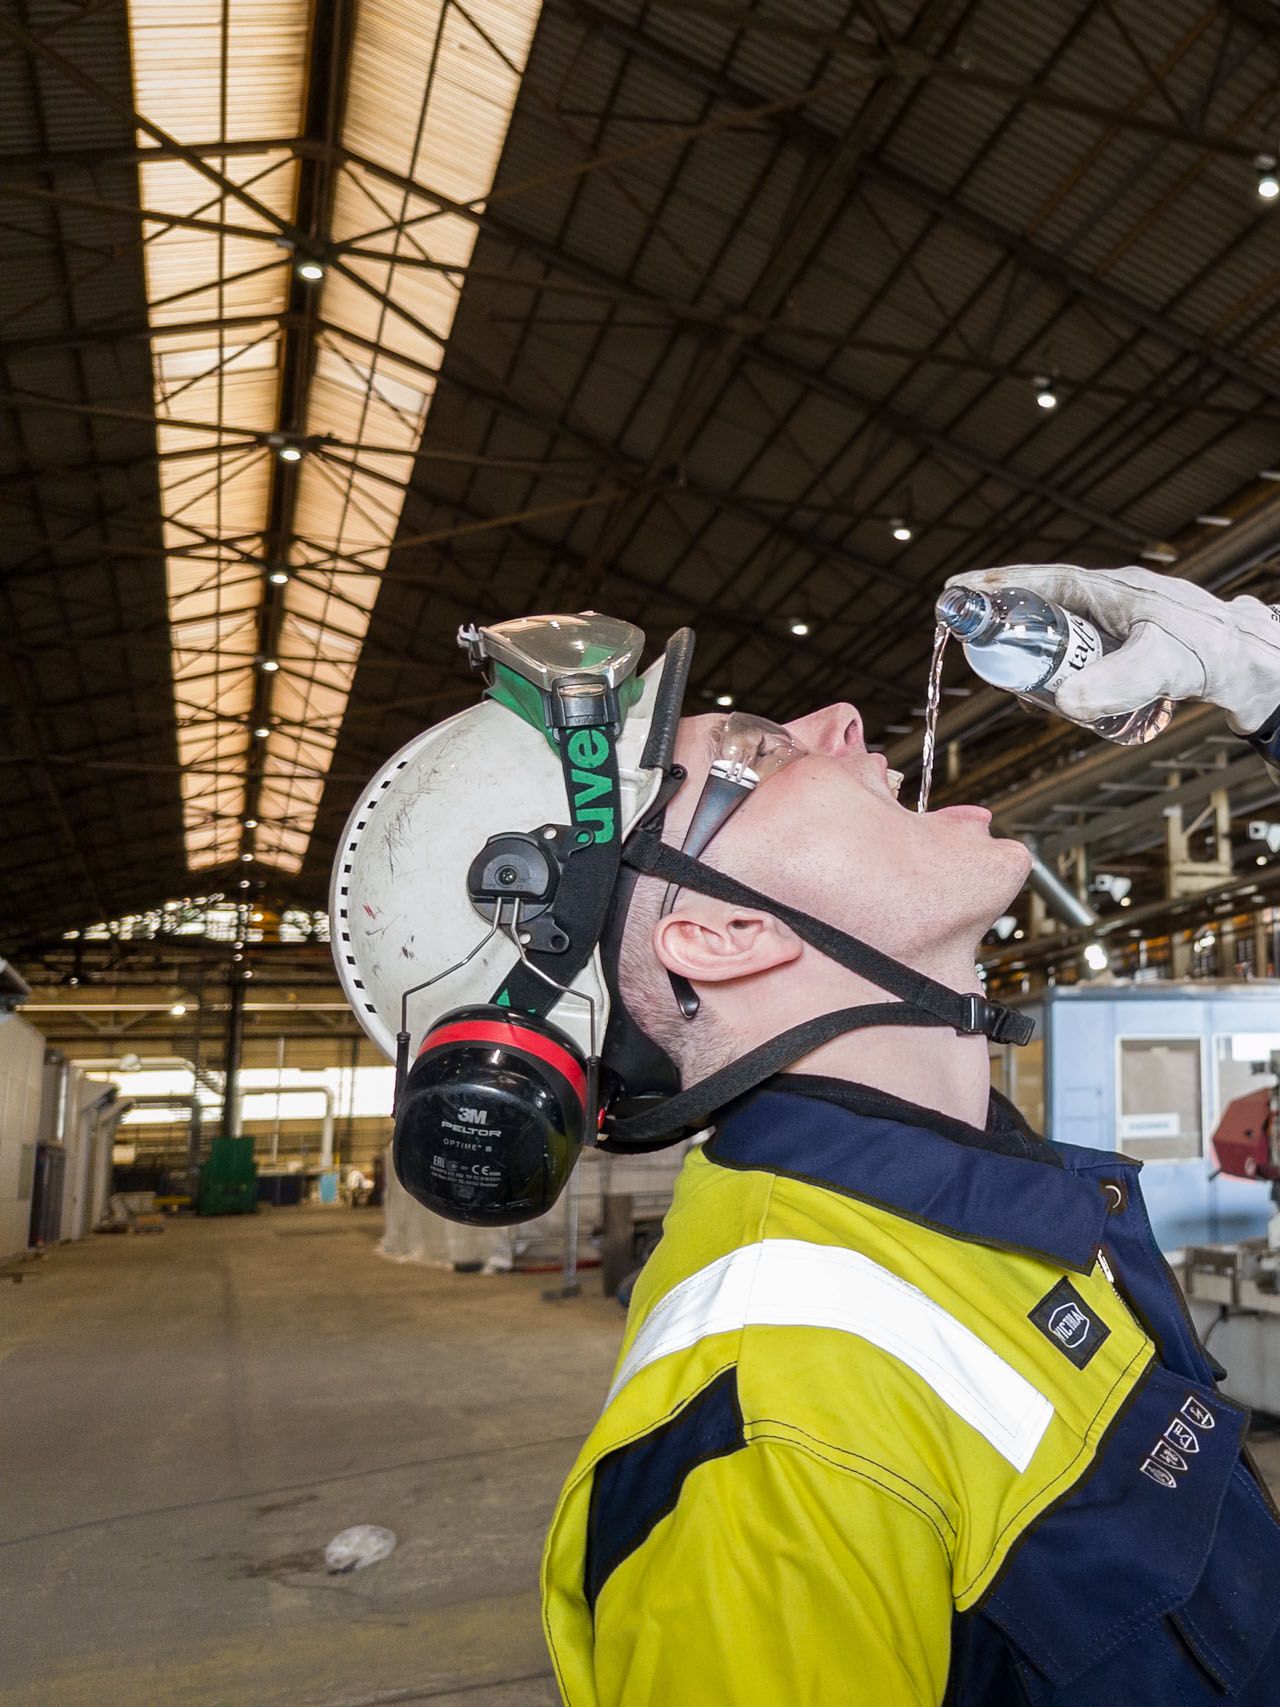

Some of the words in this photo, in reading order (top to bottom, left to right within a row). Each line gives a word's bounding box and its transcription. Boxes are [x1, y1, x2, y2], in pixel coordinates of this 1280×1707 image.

[566, 725, 614, 843] uve
[457, 1106, 487, 1124] 3M
[441, 1121, 502, 1137] PELTOR
